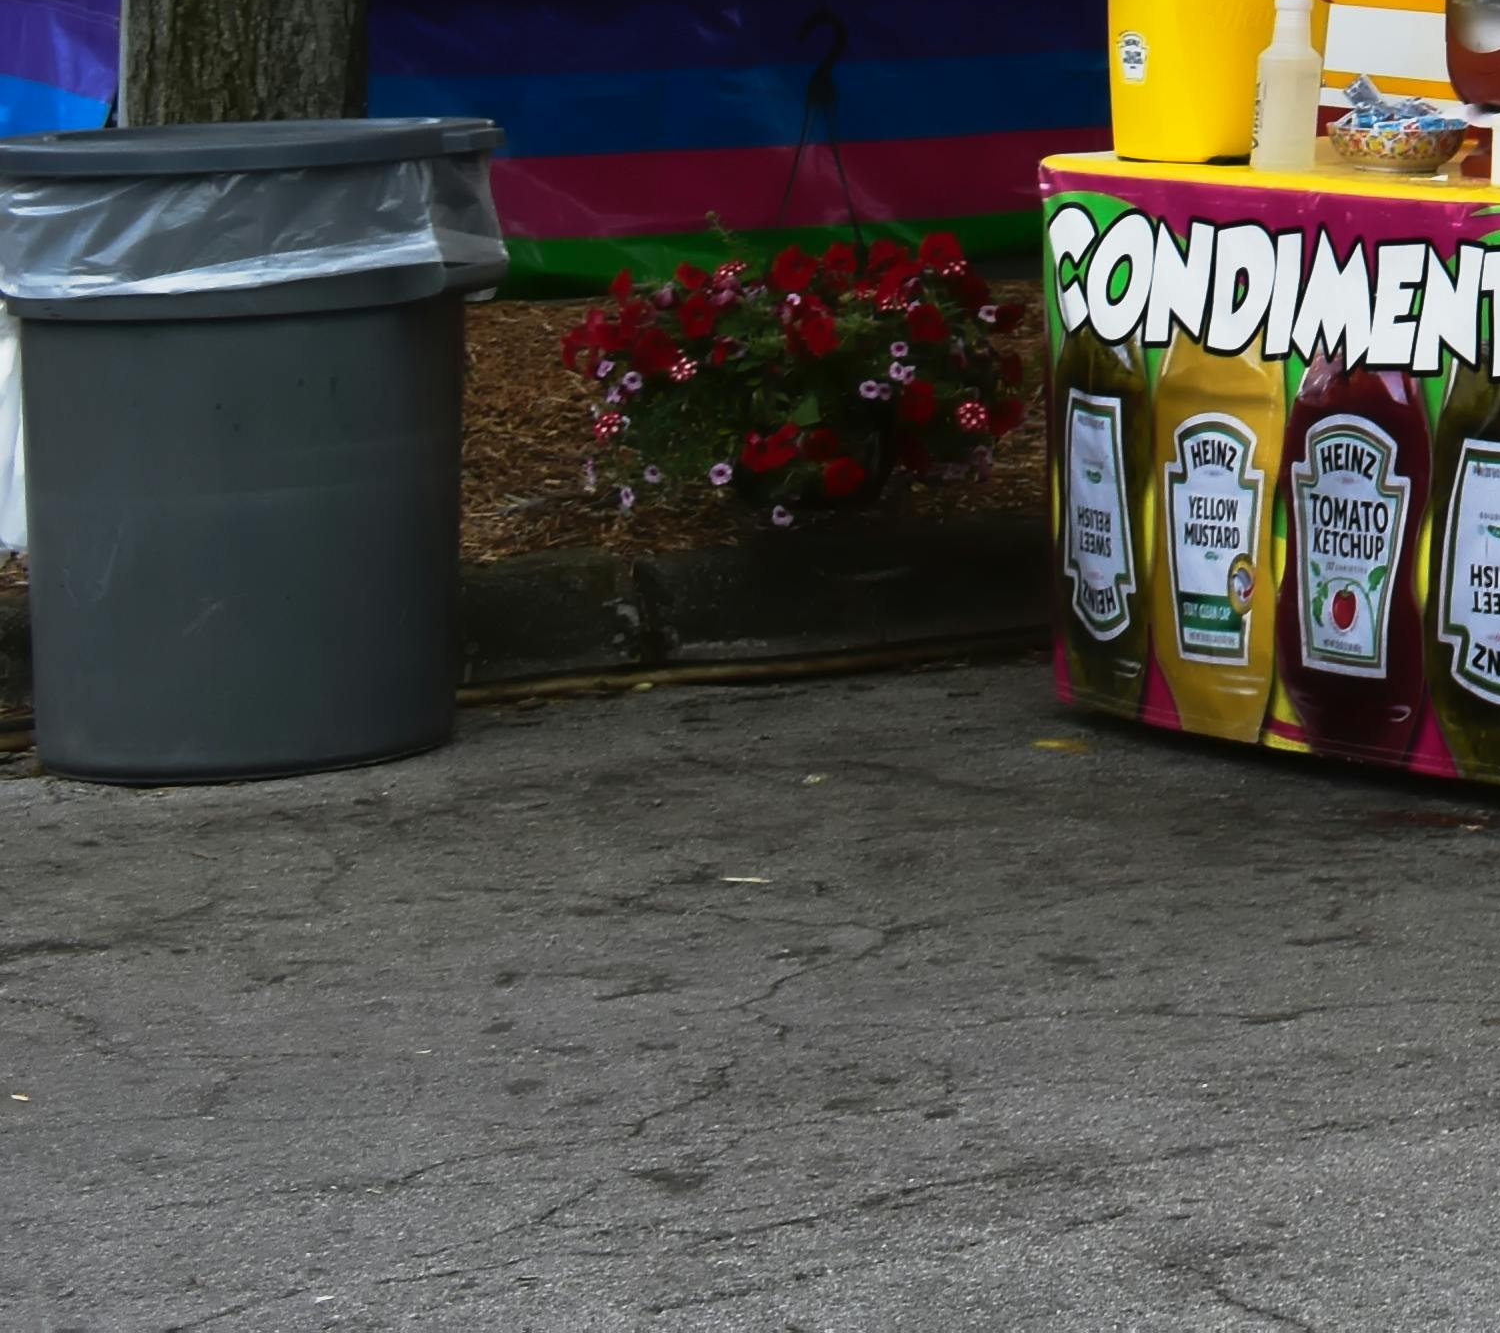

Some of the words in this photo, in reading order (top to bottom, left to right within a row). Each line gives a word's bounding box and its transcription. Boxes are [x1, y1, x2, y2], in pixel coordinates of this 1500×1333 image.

[1190, 439, 1238, 473] HEINZ
[1320, 443, 1377, 480] HEINZ
[1188, 495, 1239, 522] YELLOW
[1310, 493, 1389, 534] TOMATO
[1079, 535, 1113, 558] SWEET
[1183, 522, 1241, 550] MUSTARD
[1312, 526, 1385, 561] KETCHUP
